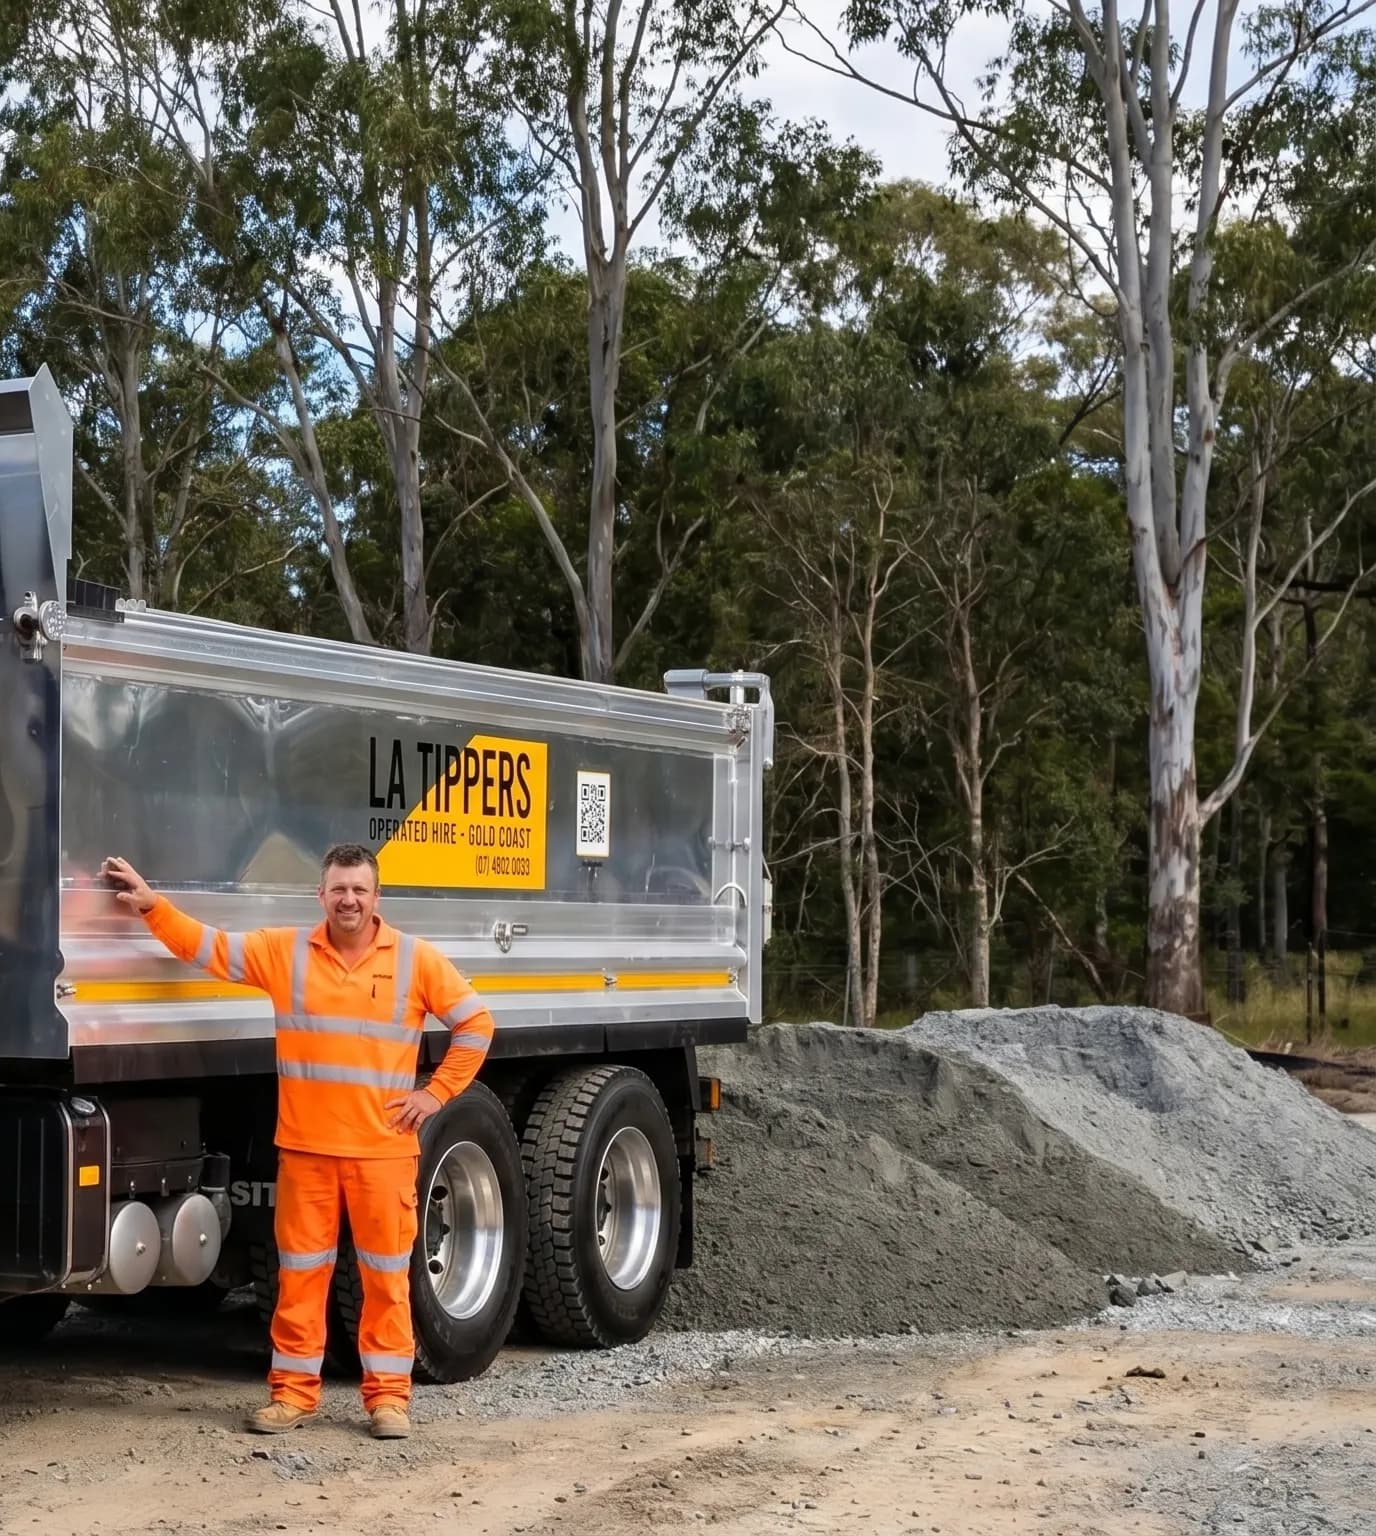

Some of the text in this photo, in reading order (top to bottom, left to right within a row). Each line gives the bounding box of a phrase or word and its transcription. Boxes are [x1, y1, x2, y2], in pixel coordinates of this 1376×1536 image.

[369, 737, 531, 819] LA TIPPERS
[369, 817, 428, 844] OPERATED
[432, 823, 456, 845] HIRE
[469, 825, 494, 847] GOLD
[499, 826, 531, 849] COAST
[475, 855, 490, 876] (07)
